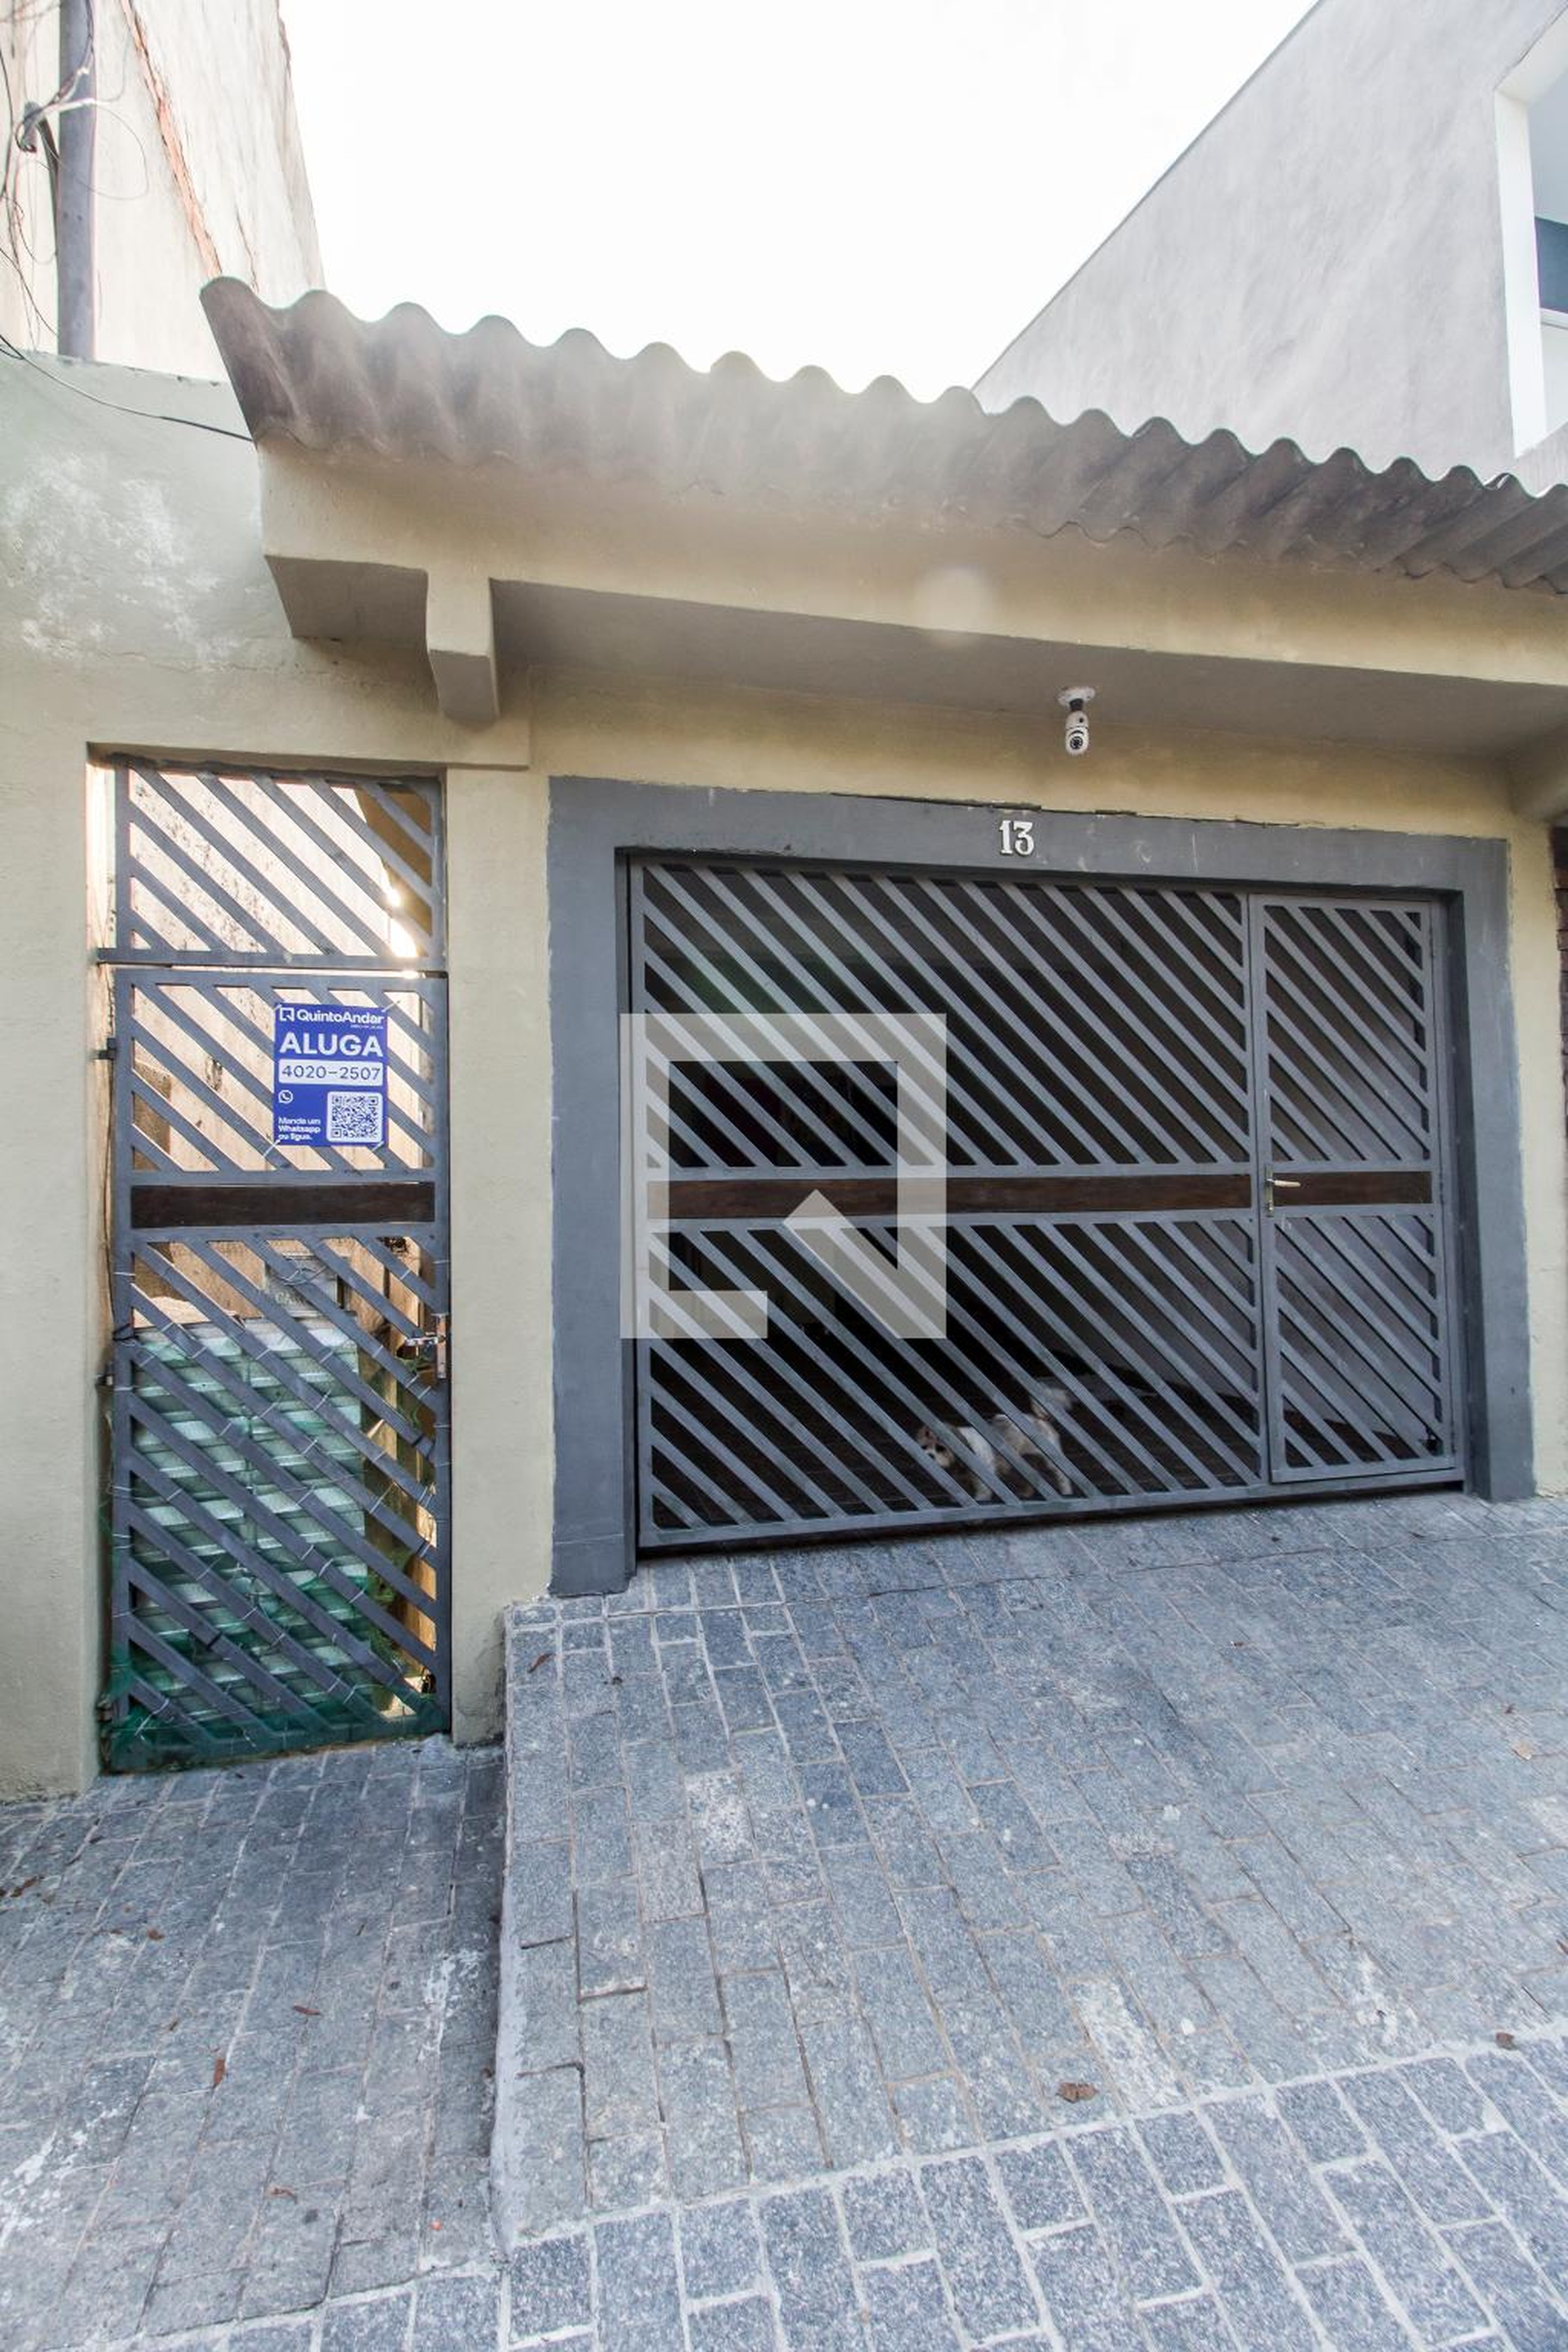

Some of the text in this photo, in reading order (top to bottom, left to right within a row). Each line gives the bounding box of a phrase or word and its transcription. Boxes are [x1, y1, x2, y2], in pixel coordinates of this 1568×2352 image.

[1000, 820, 1034, 855] 13
[296, 1009, 385, 1024] QuintoAndar
[279, 1031, 383, 1057] ALUGA
[282, 1065, 381, 1081] 4020-2507
